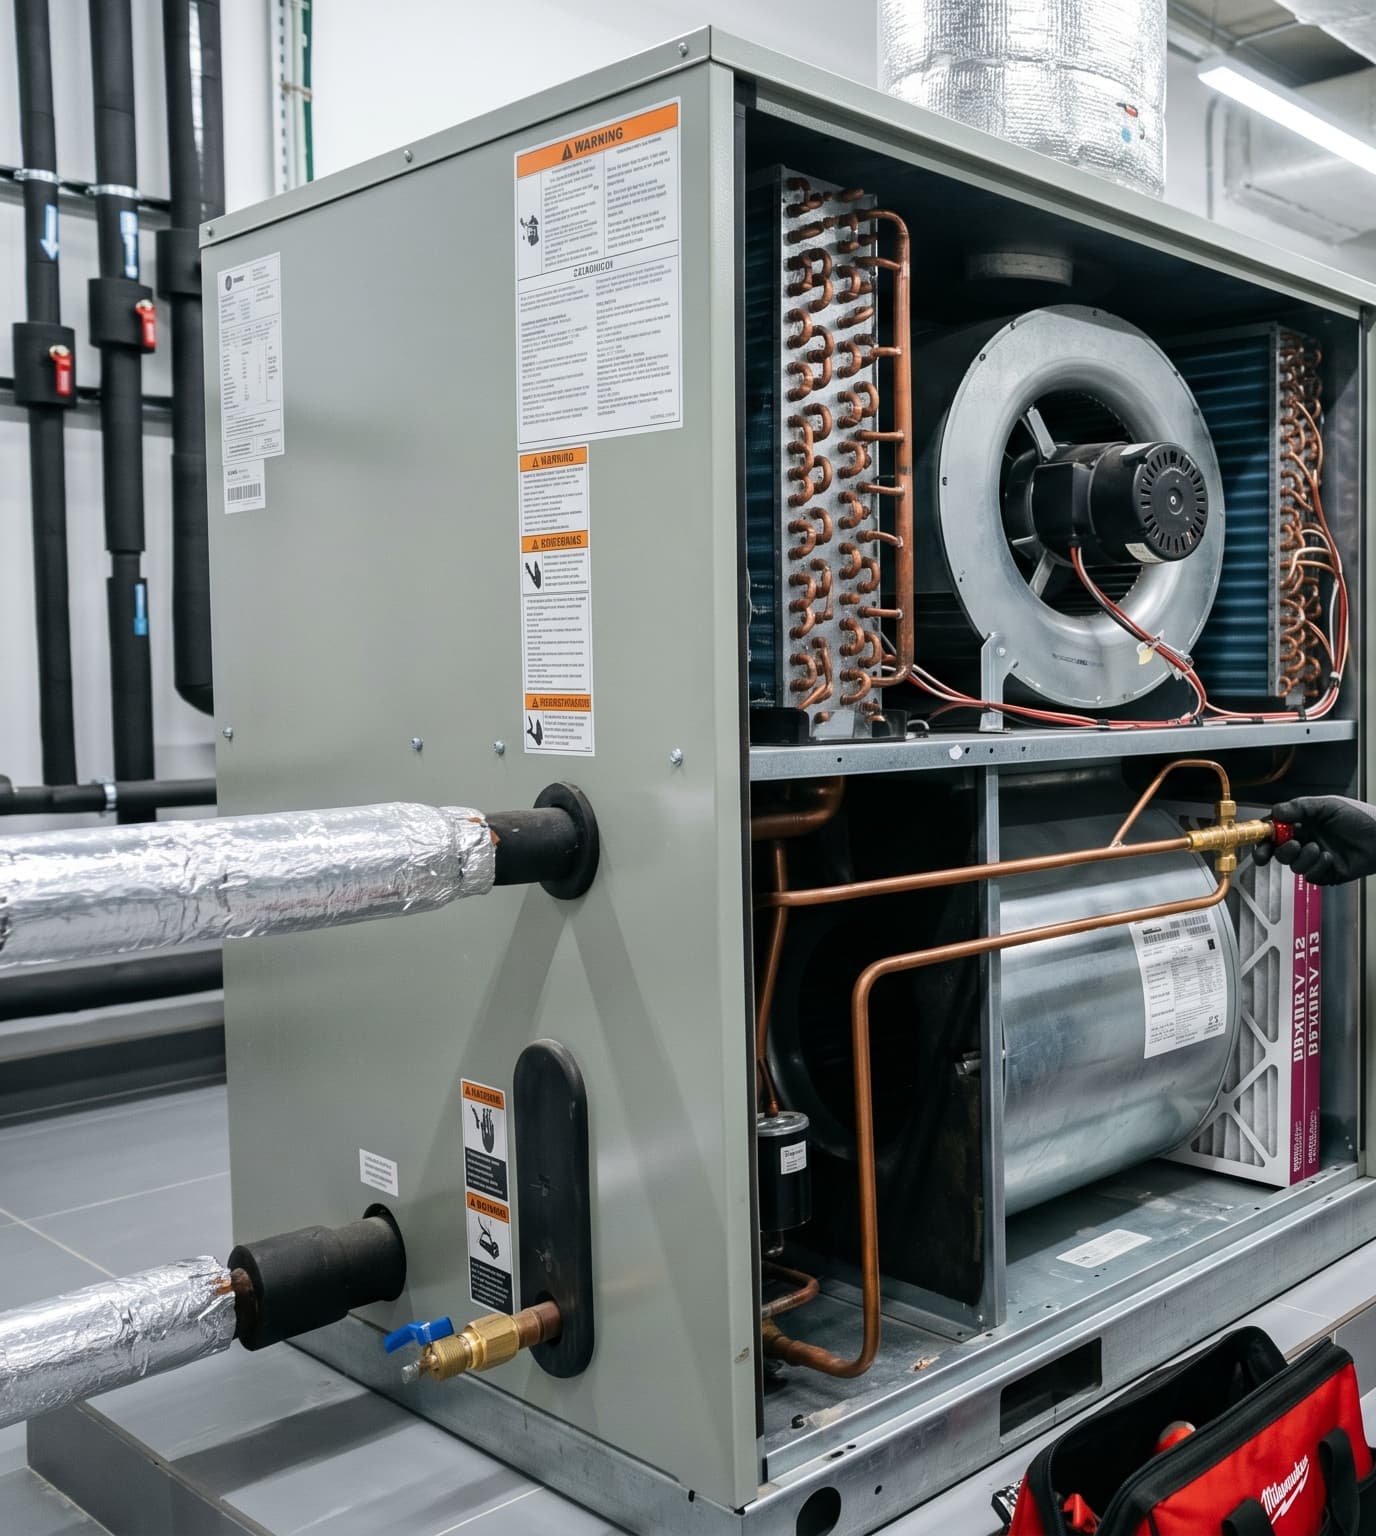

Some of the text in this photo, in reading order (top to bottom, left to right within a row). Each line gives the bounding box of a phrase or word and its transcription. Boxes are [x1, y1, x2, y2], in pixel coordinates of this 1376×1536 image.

[574, 127, 623, 153] WARNING
[1295, 936, 1306, 960] 12
[1309, 931, 1320, 957] 13
